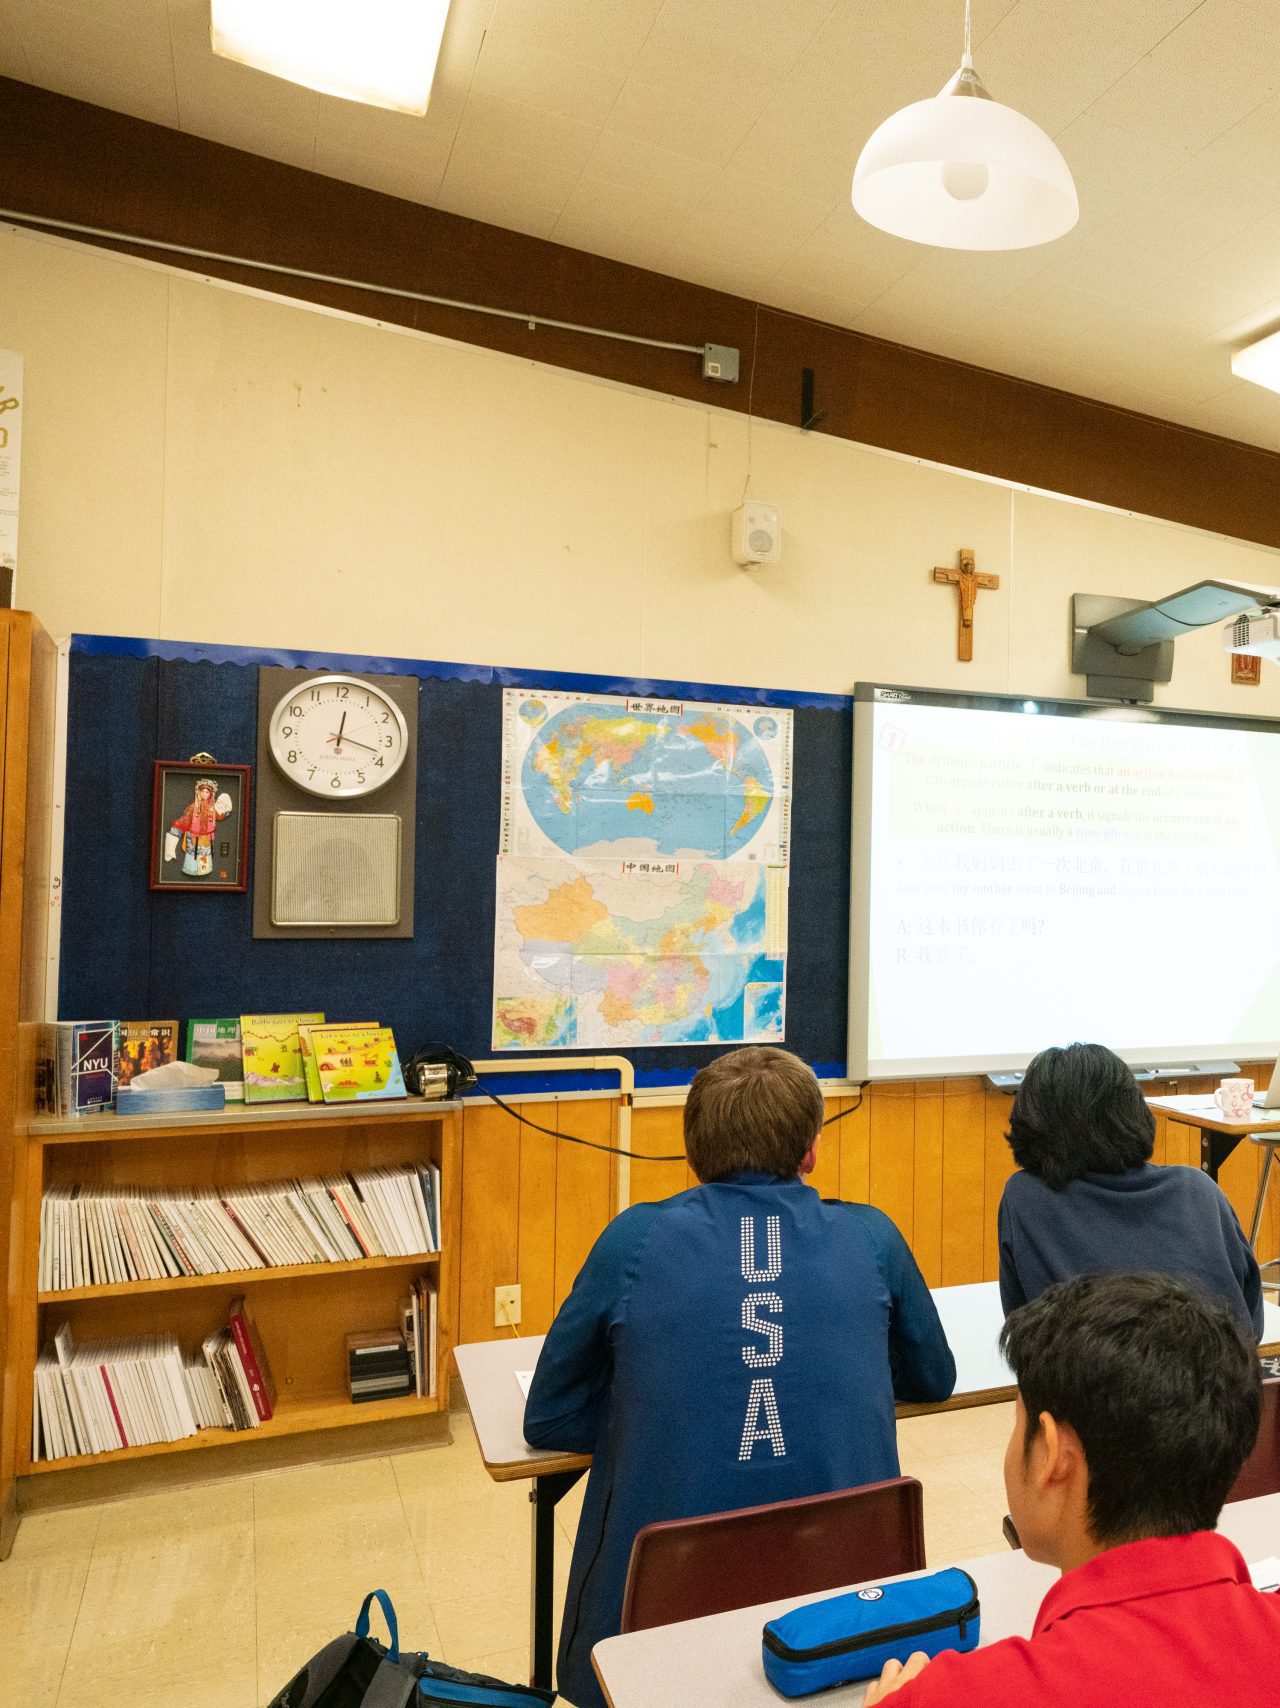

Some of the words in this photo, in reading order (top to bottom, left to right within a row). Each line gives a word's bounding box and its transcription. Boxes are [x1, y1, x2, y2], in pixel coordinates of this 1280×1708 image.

[311, 690, 320, 701] 11
[336, 687, 349, 698] 12
[366, 696, 370, 707] 1
[289, 706, 302, 717] 10
[381, 712, 389, 723] 2
[282, 726, 292, 738] 9
[385, 736, 393, 748] 3
[287, 750, 297, 764] 8
[374, 755, 384, 768] 4
[904, 752, 925, 767] The
[928, 754, 976, 770] dynamic
[1044, 760, 1091, 776] indicates
[1093, 763, 1114, 777] that
[306, 769, 315, 781] 7
[357, 772, 365, 784] 5
[330, 776, 341, 788] 6
[926, 776, 946, 786] can
[950, 777, 989, 791] appear
[991, 777, 1024, 790] either
[1026, 779, 1054, 791] after
[1056, 783, 1063, 792] a
[1065, 781, 1091, 793] verb
[1094, 784, 1106, 793] or
[1108, 783, 1119, 795] at
[1121, 783, 1140, 796] the
[1142, 785, 1161, 797] end
[971, 807, 1014, 820] appears
[1017, 805, 1045, 818] after
[1048, 809, 1054, 818] a
[1057, 807, 1084, 821] verb,
[1097, 810, 1132, 825] signals
[1134, 811, 1150, 823] the
[1152, 814, 1210, 825] occurrence
[1212, 812, 1224, 825] of
[980, 822, 1014, 836] There
[1016, 824, 1024, 836] is
[1026, 825, 1065, 841] usually
[1067, 829, 1073, 838] a
[626, 862, 675, 873] 中国地图
[952, 884, 970, 896] my
[973, 881, 1013, 894] mother
[1015, 883, 1043, 895] went
[1045, 883, 1056, 895] to
[1059, 883, 1095, 898] Beijing
[1097, 884, 1116, 896] and
[1152, 884, 1179, 897] there
[83, 1057, 108, 1071] NYU
